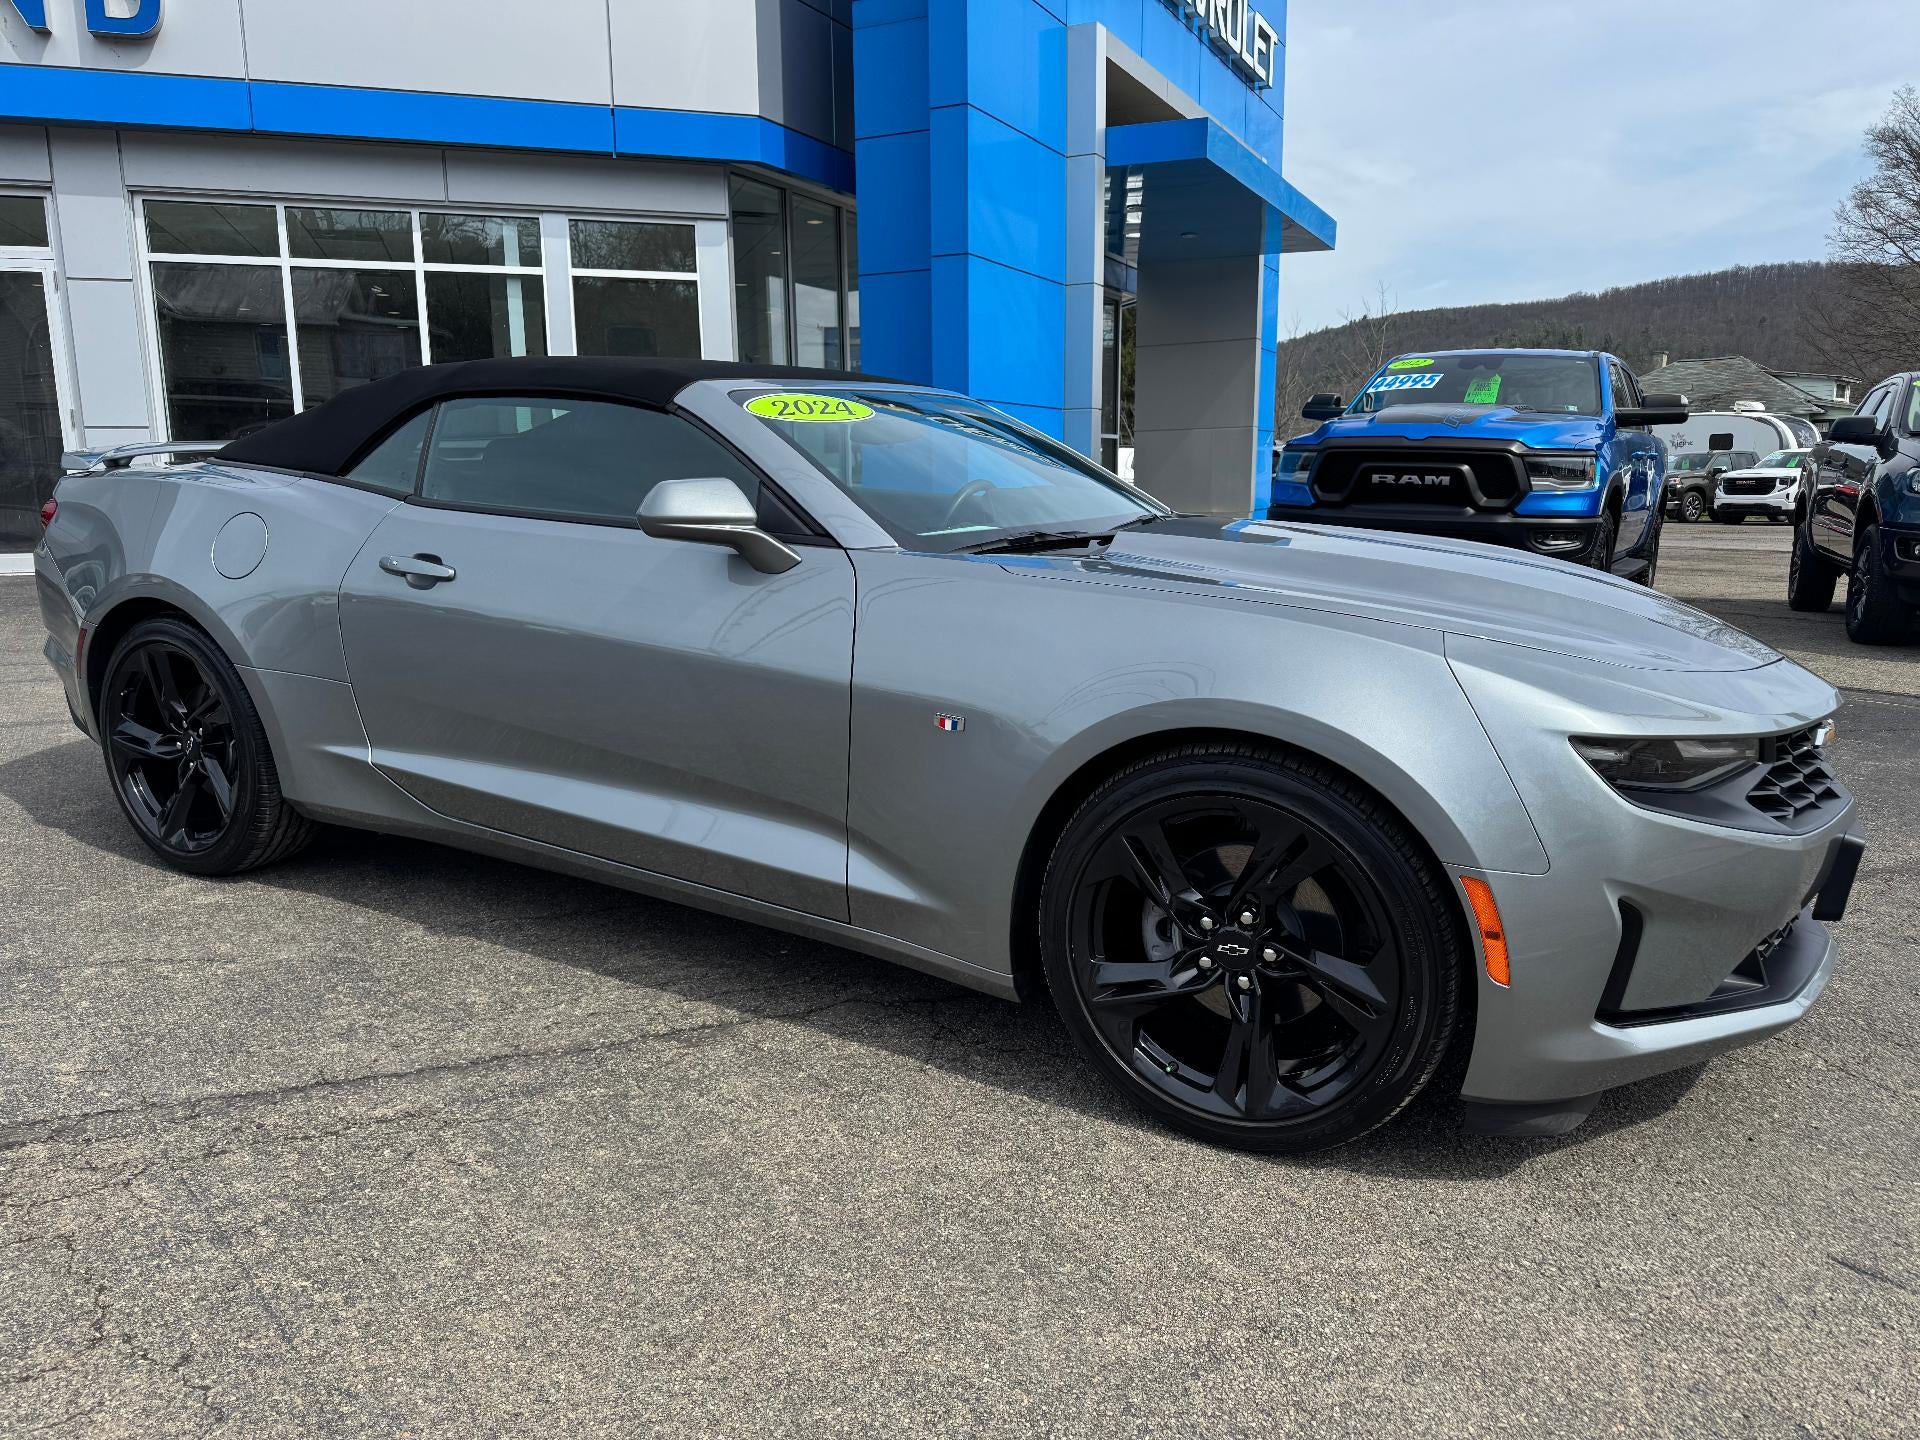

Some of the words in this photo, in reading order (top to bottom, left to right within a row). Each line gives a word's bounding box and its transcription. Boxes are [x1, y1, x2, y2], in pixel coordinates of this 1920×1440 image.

[1371, 374, 1440, 391] 44995
[771, 399, 857, 417] 2024
[1372, 474, 1451, 486] RAM
